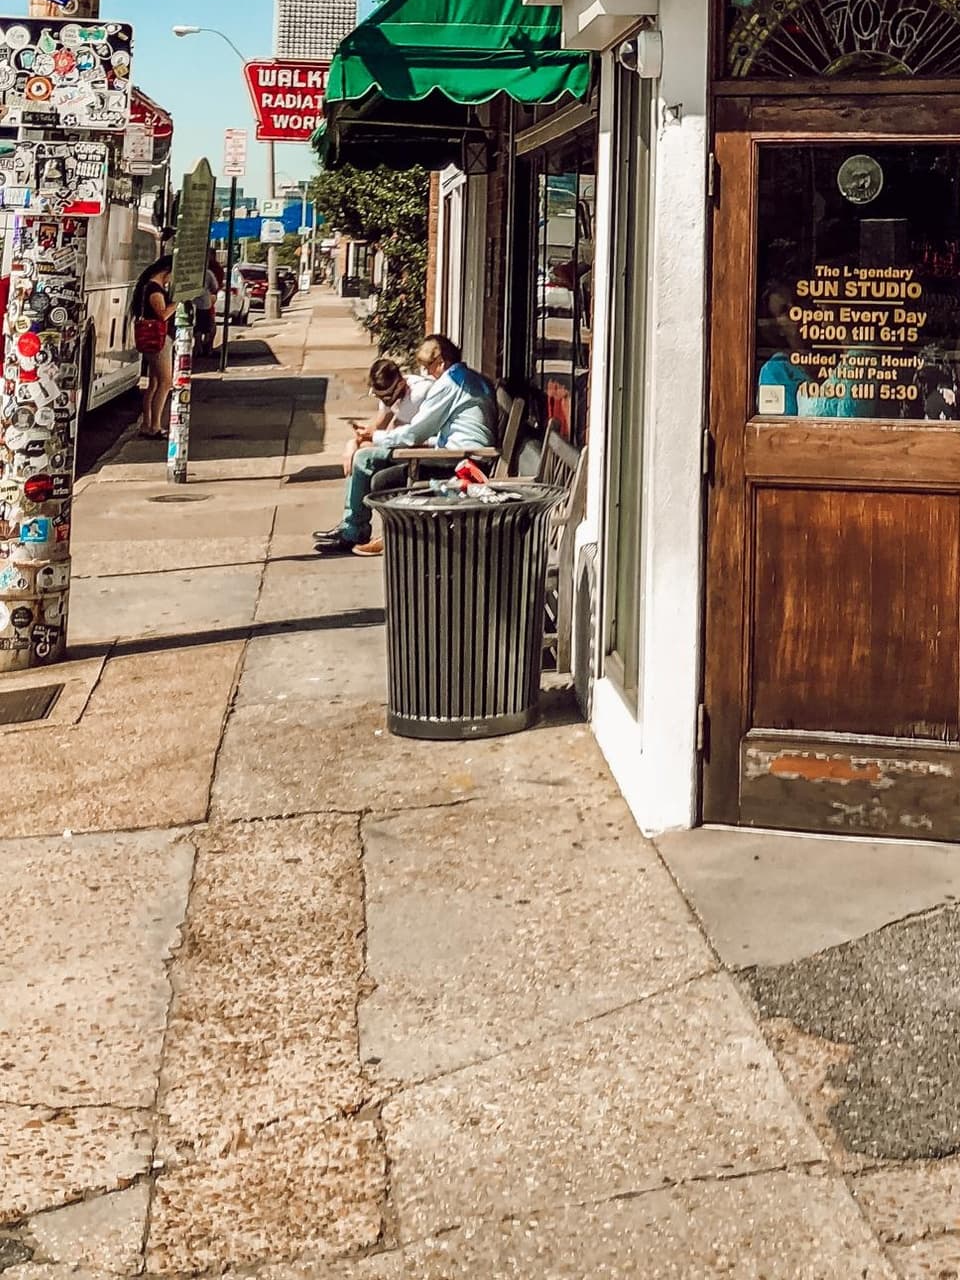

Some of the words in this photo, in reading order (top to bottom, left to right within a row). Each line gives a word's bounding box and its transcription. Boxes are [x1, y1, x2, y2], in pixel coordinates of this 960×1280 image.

[257, 67, 329, 89] WALK
[261, 92, 323, 110] RADIAT
[815, 265, 840, 277] The
[796, 280, 839, 297] SUN
[845, 281, 922, 298] STUDIO
[789, 306, 834, 324] Open
[840, 307, 889, 326] Every
[894, 309, 927, 327] Day
[800, 324, 847, 340] 10:00
[851, 326, 875, 341] till
[880, 327, 918, 342] 6:15
[790, 352, 836, 366] Guided
[840, 354, 878, 367] Tours
[881, 355, 925, 370] Hourly
[818, 366, 833, 378] At
[836, 367, 865, 379] Half
[867, 368, 898, 380] Past
[851, 383, 875, 399] till
[880, 384, 918, 400] 5:30
